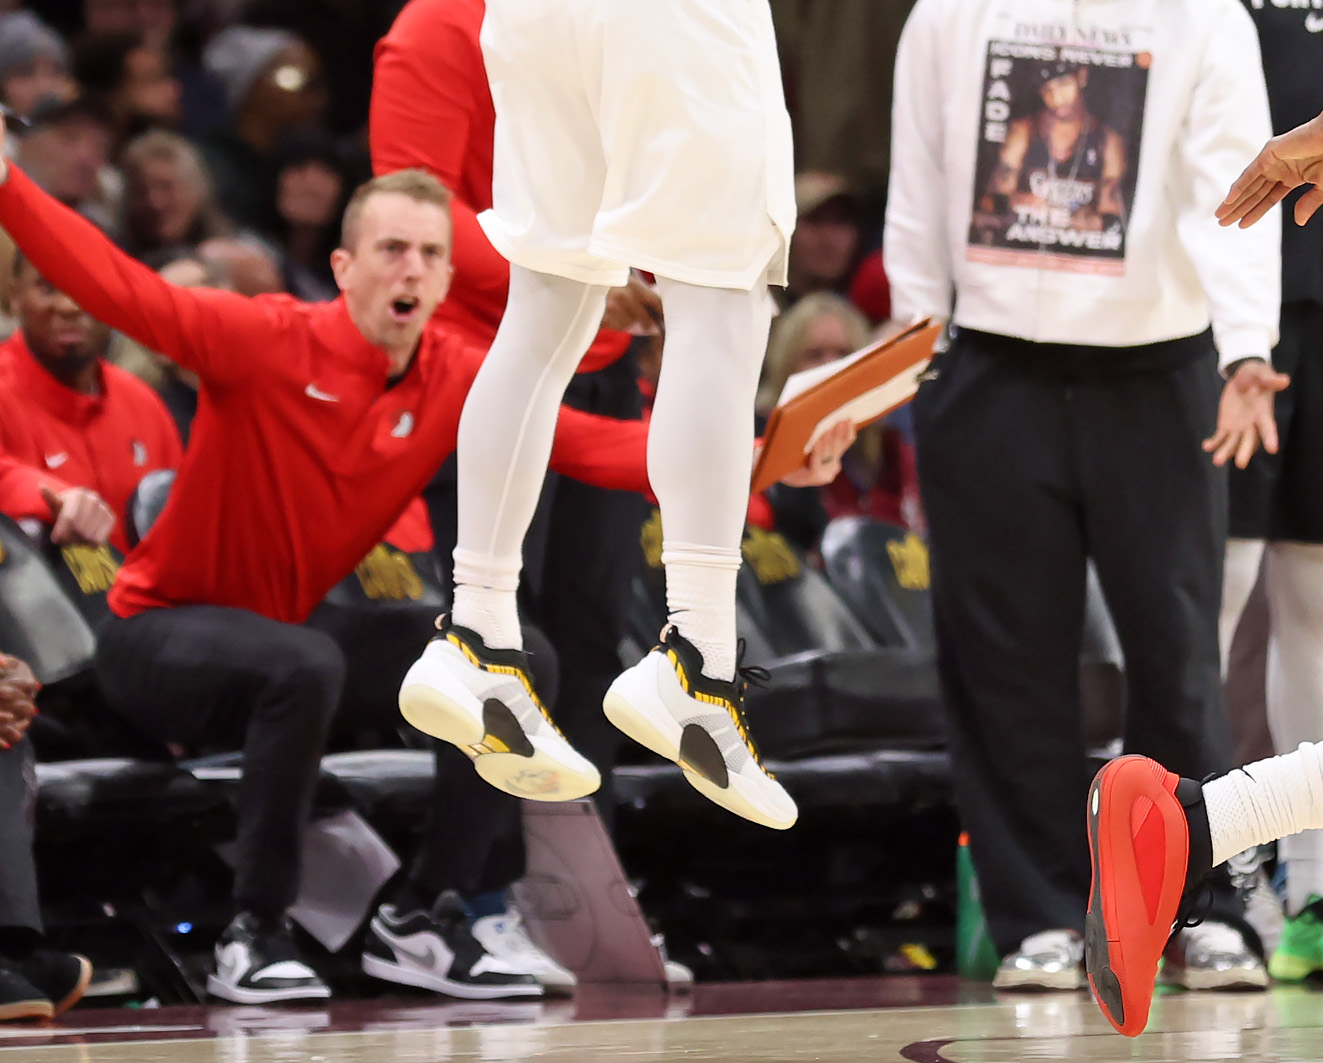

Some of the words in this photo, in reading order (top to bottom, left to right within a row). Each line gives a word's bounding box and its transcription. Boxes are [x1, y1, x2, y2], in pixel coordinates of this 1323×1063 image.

[985, 57, 1013, 143] FADE
[1013, 204, 1072, 229] THE
[1005, 223, 1122, 250] ANSWER
